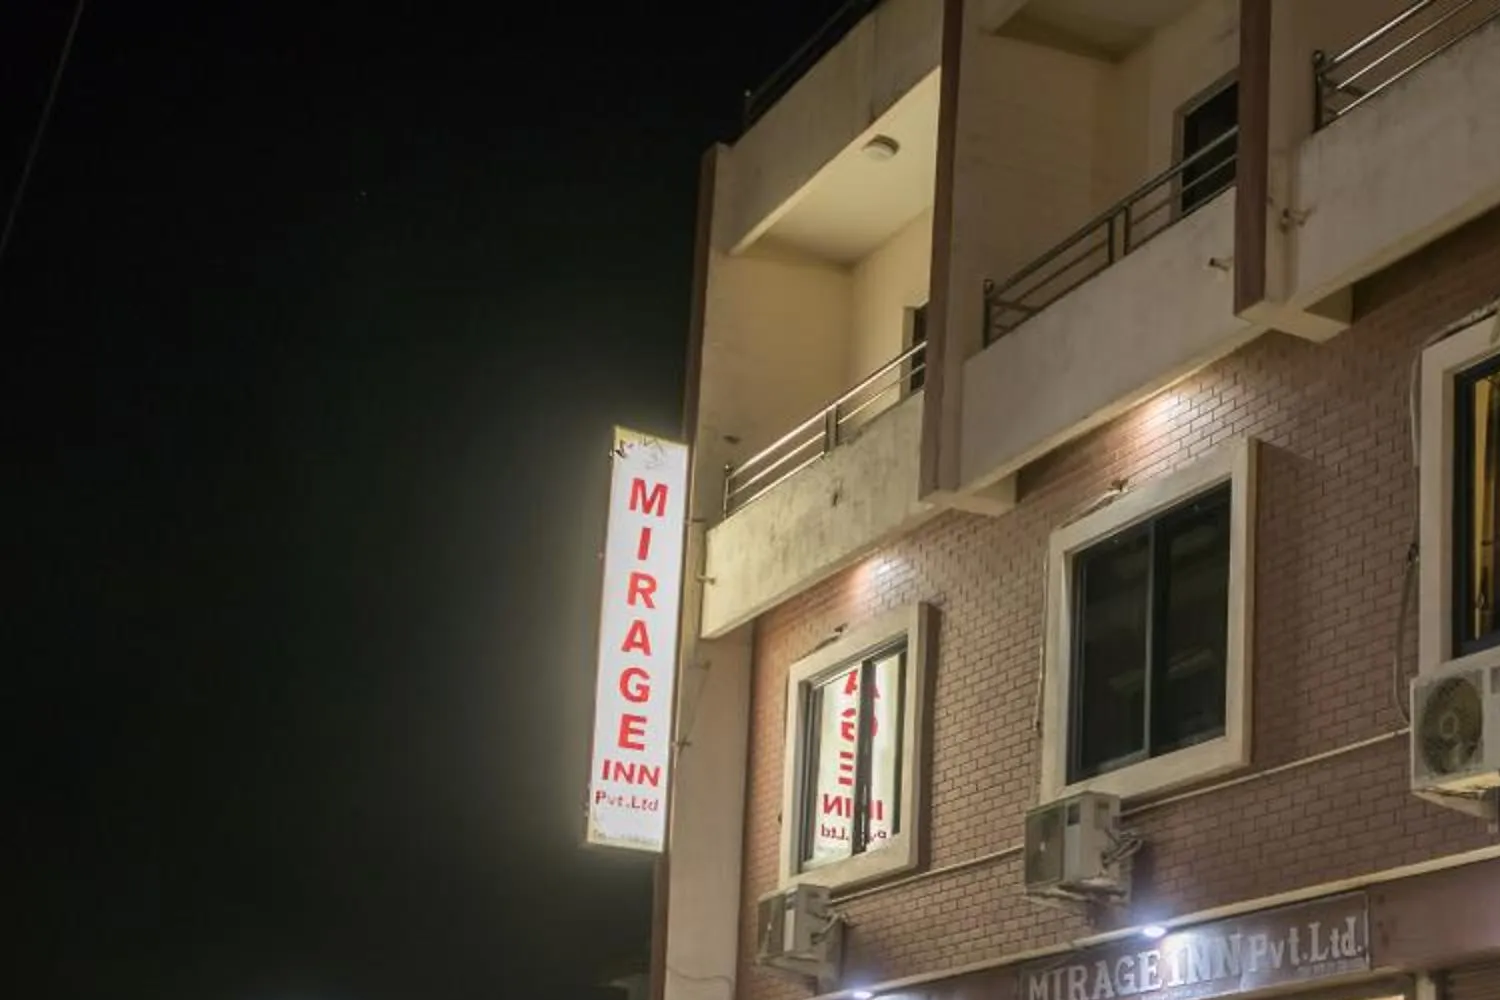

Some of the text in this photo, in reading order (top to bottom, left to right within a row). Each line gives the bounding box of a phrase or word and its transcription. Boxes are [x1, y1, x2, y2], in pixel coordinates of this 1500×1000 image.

[617, 477, 669, 751] MIRAGE
[602, 759, 661, 787] INN
[1166, 932, 1242, 987] INN
